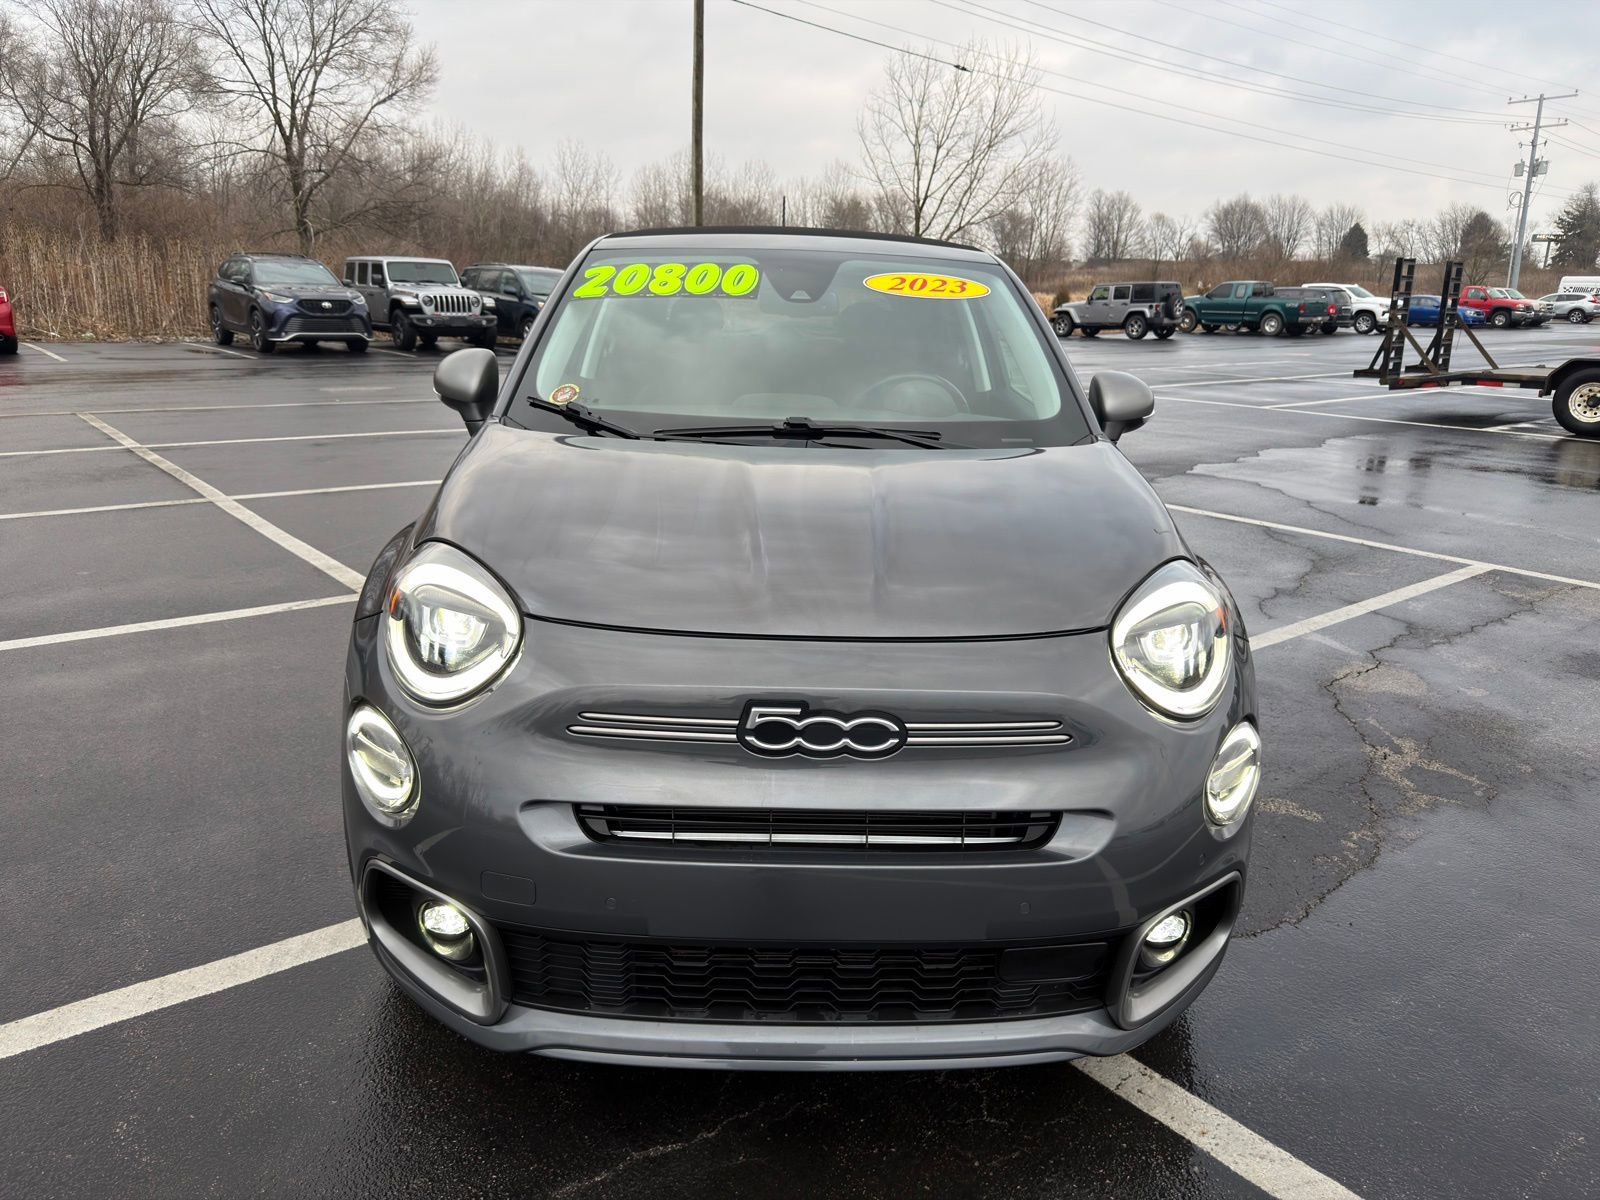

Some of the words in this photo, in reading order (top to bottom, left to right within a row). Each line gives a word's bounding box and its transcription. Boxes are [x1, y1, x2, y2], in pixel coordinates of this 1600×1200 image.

[573, 262, 760, 298] 20800
[887, 276, 968, 294] 2023
[744, 706, 901, 752] 500
